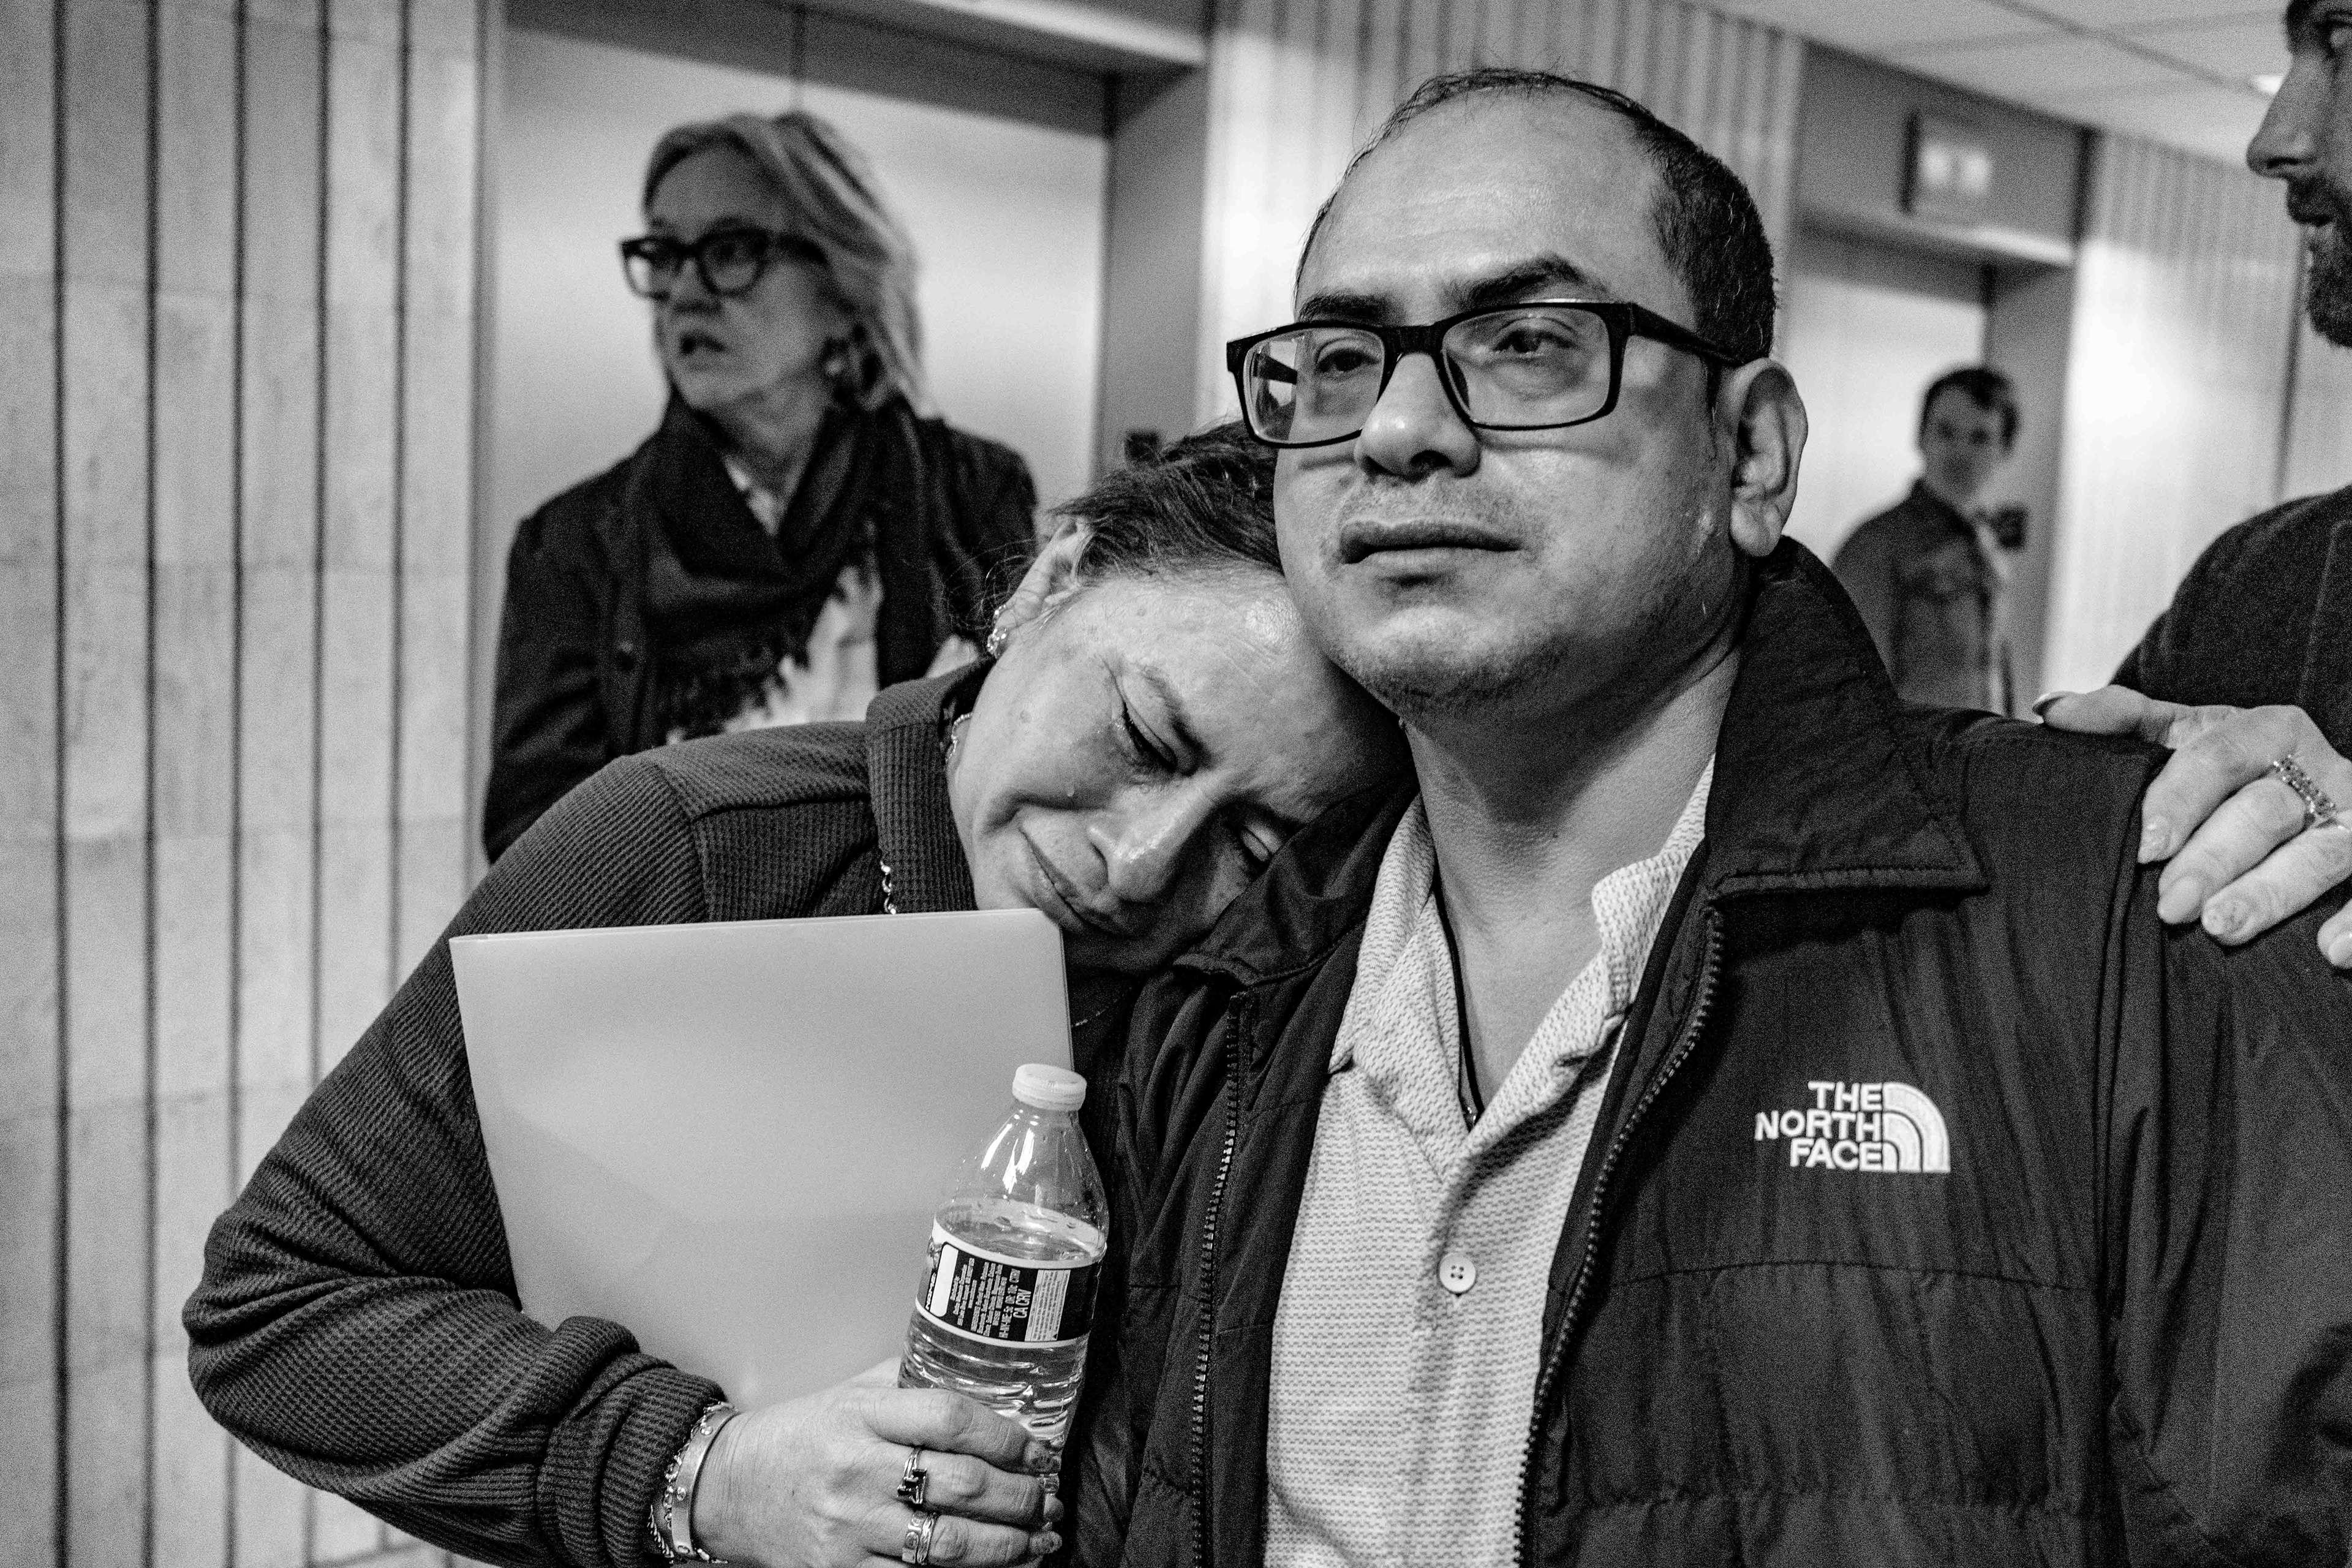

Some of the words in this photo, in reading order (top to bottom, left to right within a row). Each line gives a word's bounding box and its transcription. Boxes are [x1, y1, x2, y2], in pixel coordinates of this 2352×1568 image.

[1807, 1080, 1883, 1112] THE
[1754, 1109, 1882, 1142] NORTH
[1790, 1137, 1883, 1172] FACE
[1012, 1307, 1028, 1318] CA
[1016, 1288, 1031, 1306] CRV
